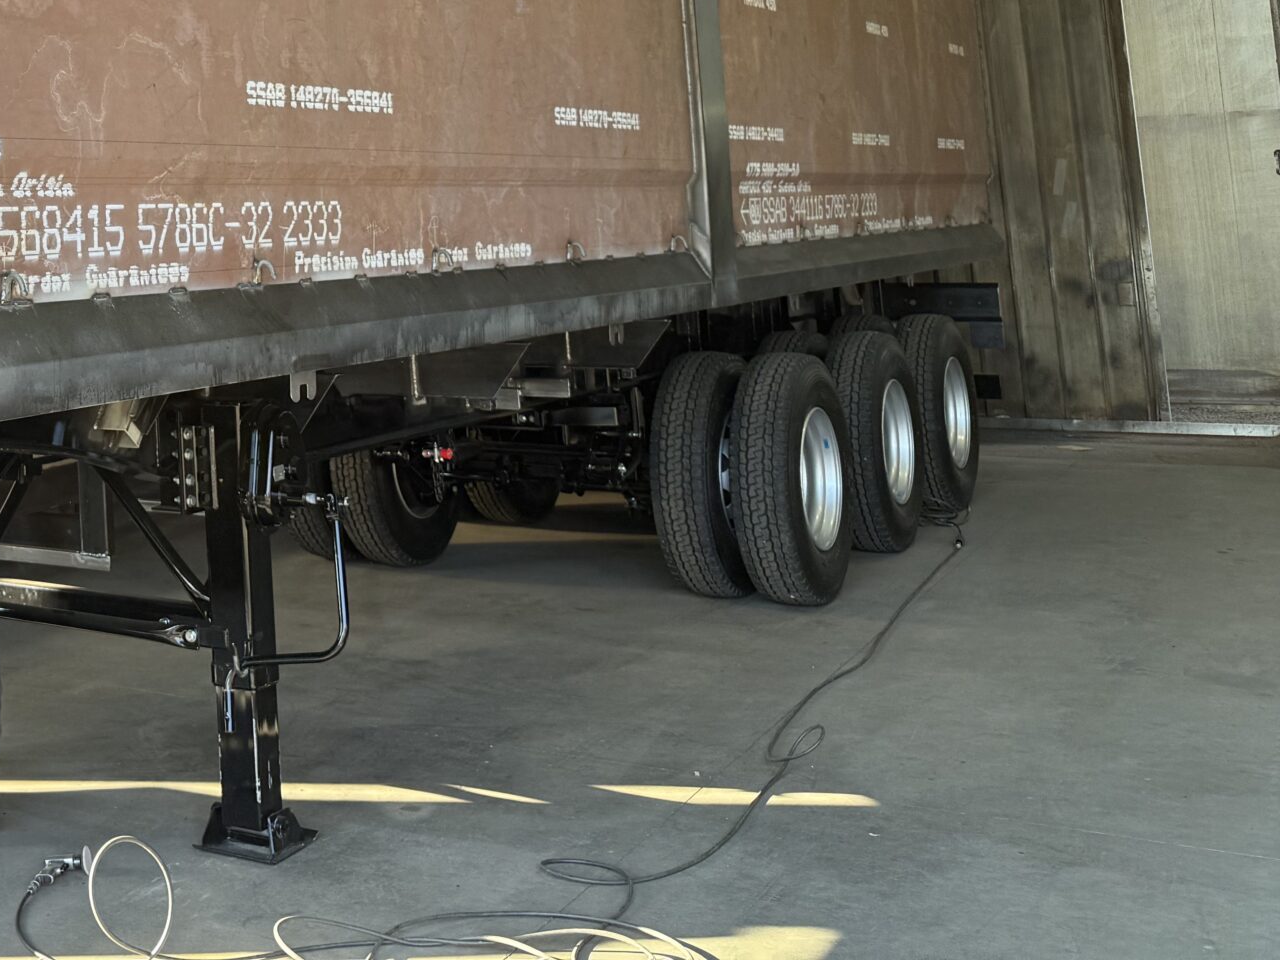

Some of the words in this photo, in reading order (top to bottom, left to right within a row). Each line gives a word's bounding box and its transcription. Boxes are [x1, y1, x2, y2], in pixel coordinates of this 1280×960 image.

[246, 80, 286, 108] SSAB
[554, 106, 577, 126] SSAB
[762, 196, 787, 224] SSAB
[137, 201, 273, 254] 5786C-32
[283, 200, 342, 247] 2333
[295, 251, 359, 274] Precision
[362, 247, 424, 269] Guarantee
[85, 262, 190, 289] Guarantees
